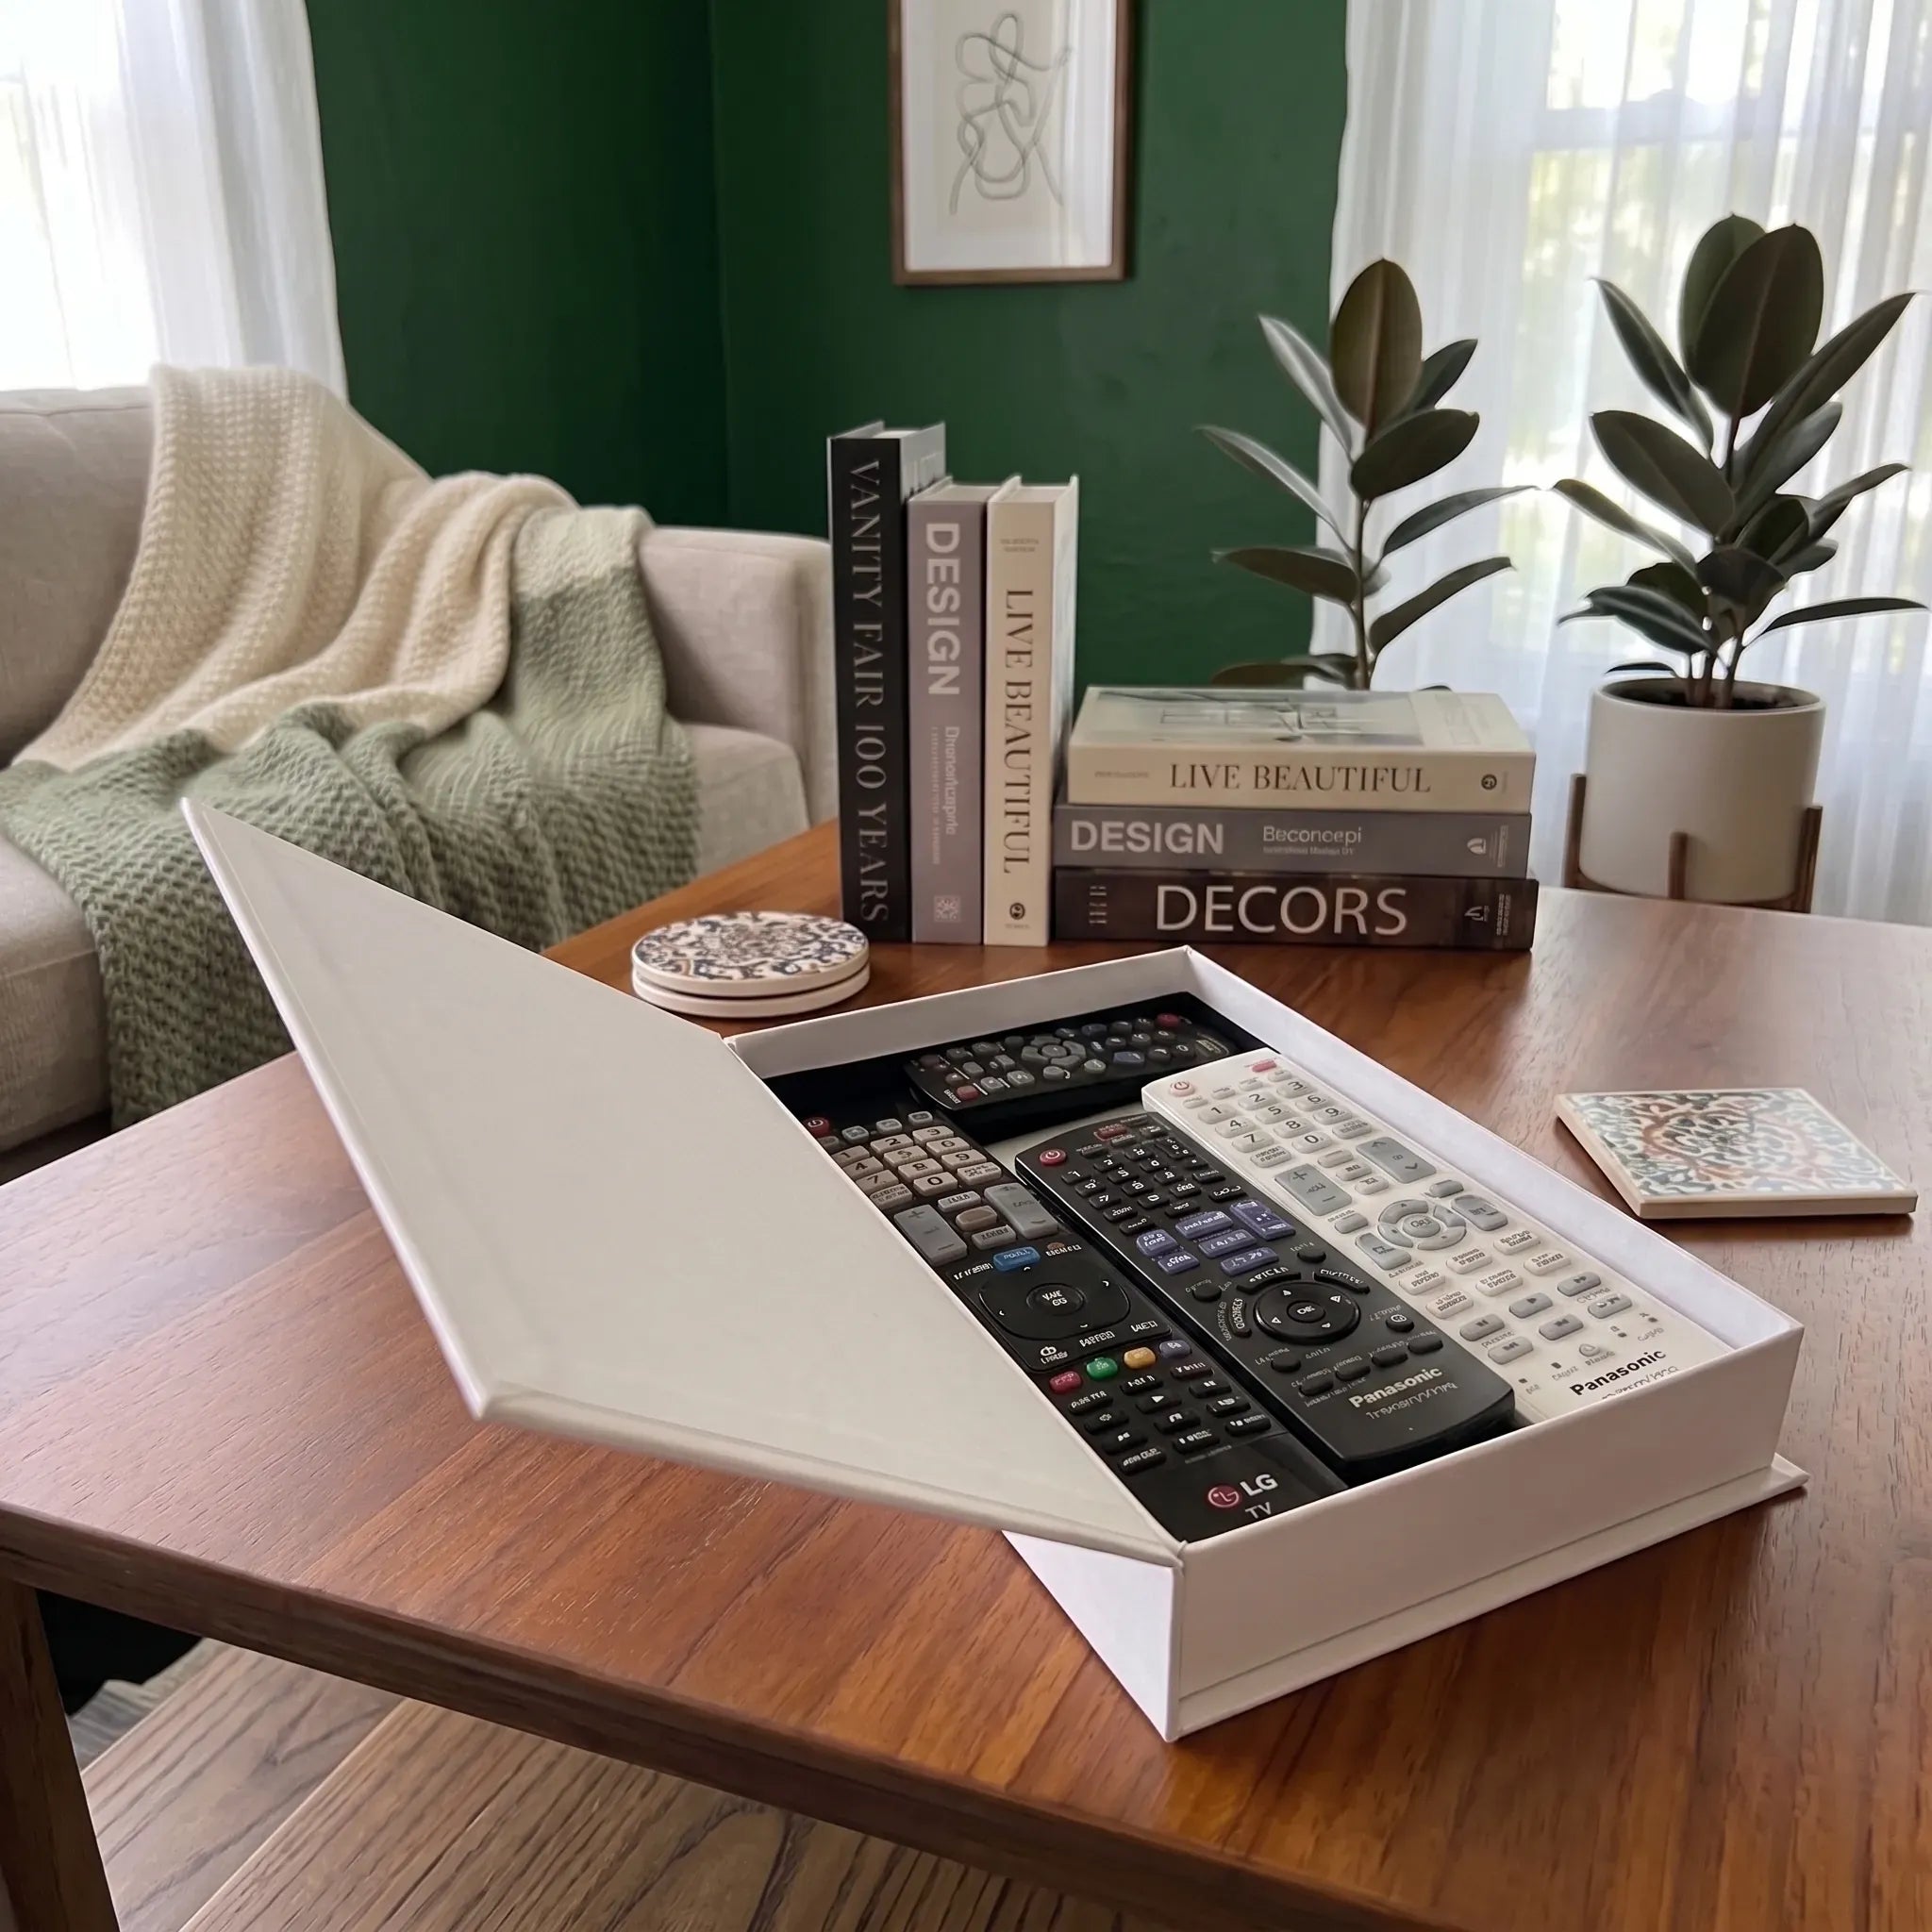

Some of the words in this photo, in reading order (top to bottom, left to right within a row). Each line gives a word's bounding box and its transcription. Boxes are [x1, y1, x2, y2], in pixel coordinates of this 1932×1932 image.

[850, 460, 883, 608] VANITY
[925, 522, 961, 696] DESIGN
[1004, 589, 1034, 669] LIVE
[853, 623, 885, 708] FAIR
[855, 724, 887, 790] 100
[1003, 680, 1033, 874] BEAUTIFUL
[1170, 763, 1241, 791] LIVE
[1253, 763, 1432, 793] BEAUTIFUL
[858, 803, 890, 922] YEARS
[1071, 819, 1224, 855] DESIGN
[1156, 883, 1407, 937] DECORS
[1248, 1093, 1266, 1103] 2
[1348, 1368, 1444, 1408] Panasonic
[1570, 1349, 1667, 1396] Panasonic
[1240, 1474, 1279, 1497] LG
[1245, 1502, 1273, 1520] TV
